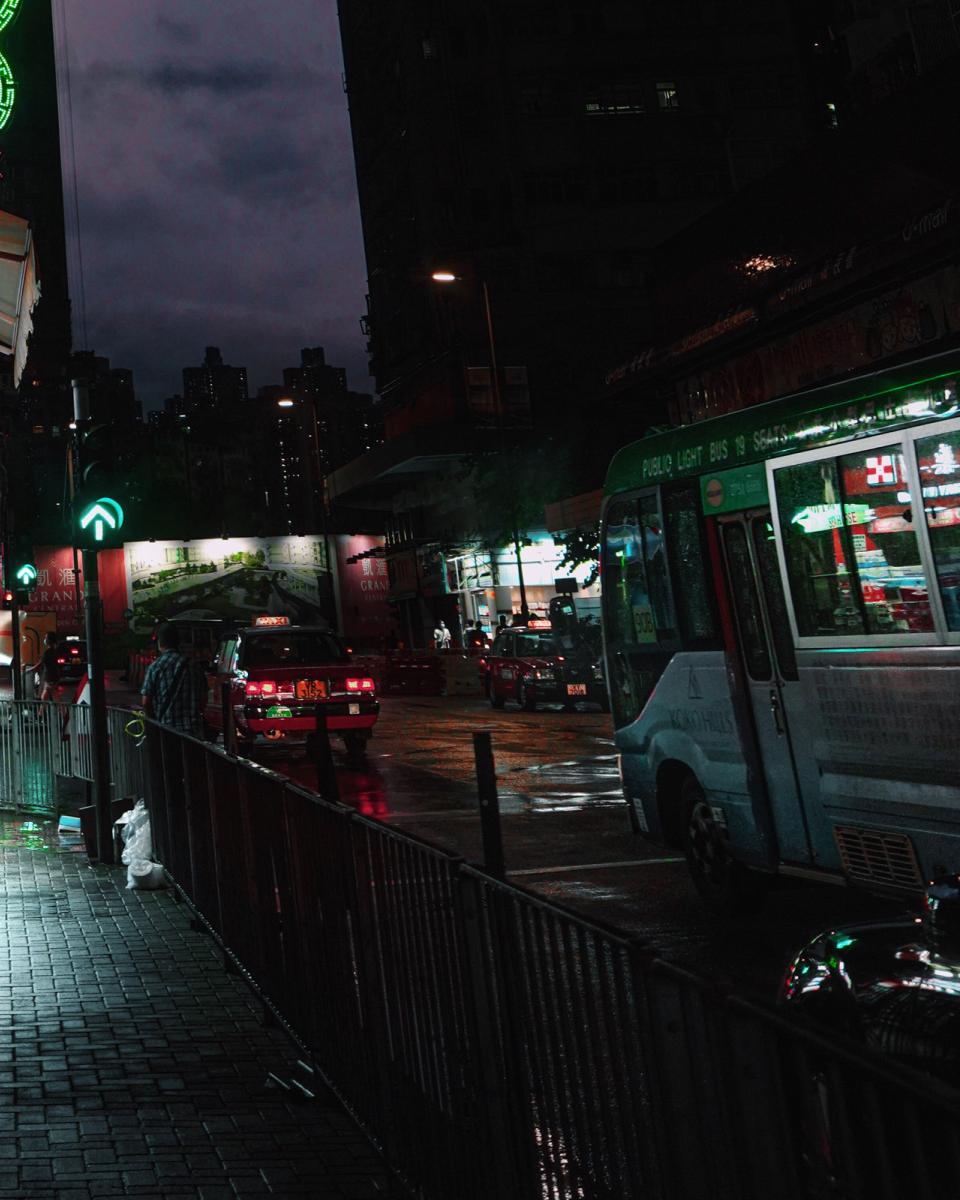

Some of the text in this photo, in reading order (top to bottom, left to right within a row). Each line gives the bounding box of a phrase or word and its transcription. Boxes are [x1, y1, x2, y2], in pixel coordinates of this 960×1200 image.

[642, 424, 788, 479] PUBLIC LIGHT BUS 19 SEATS
